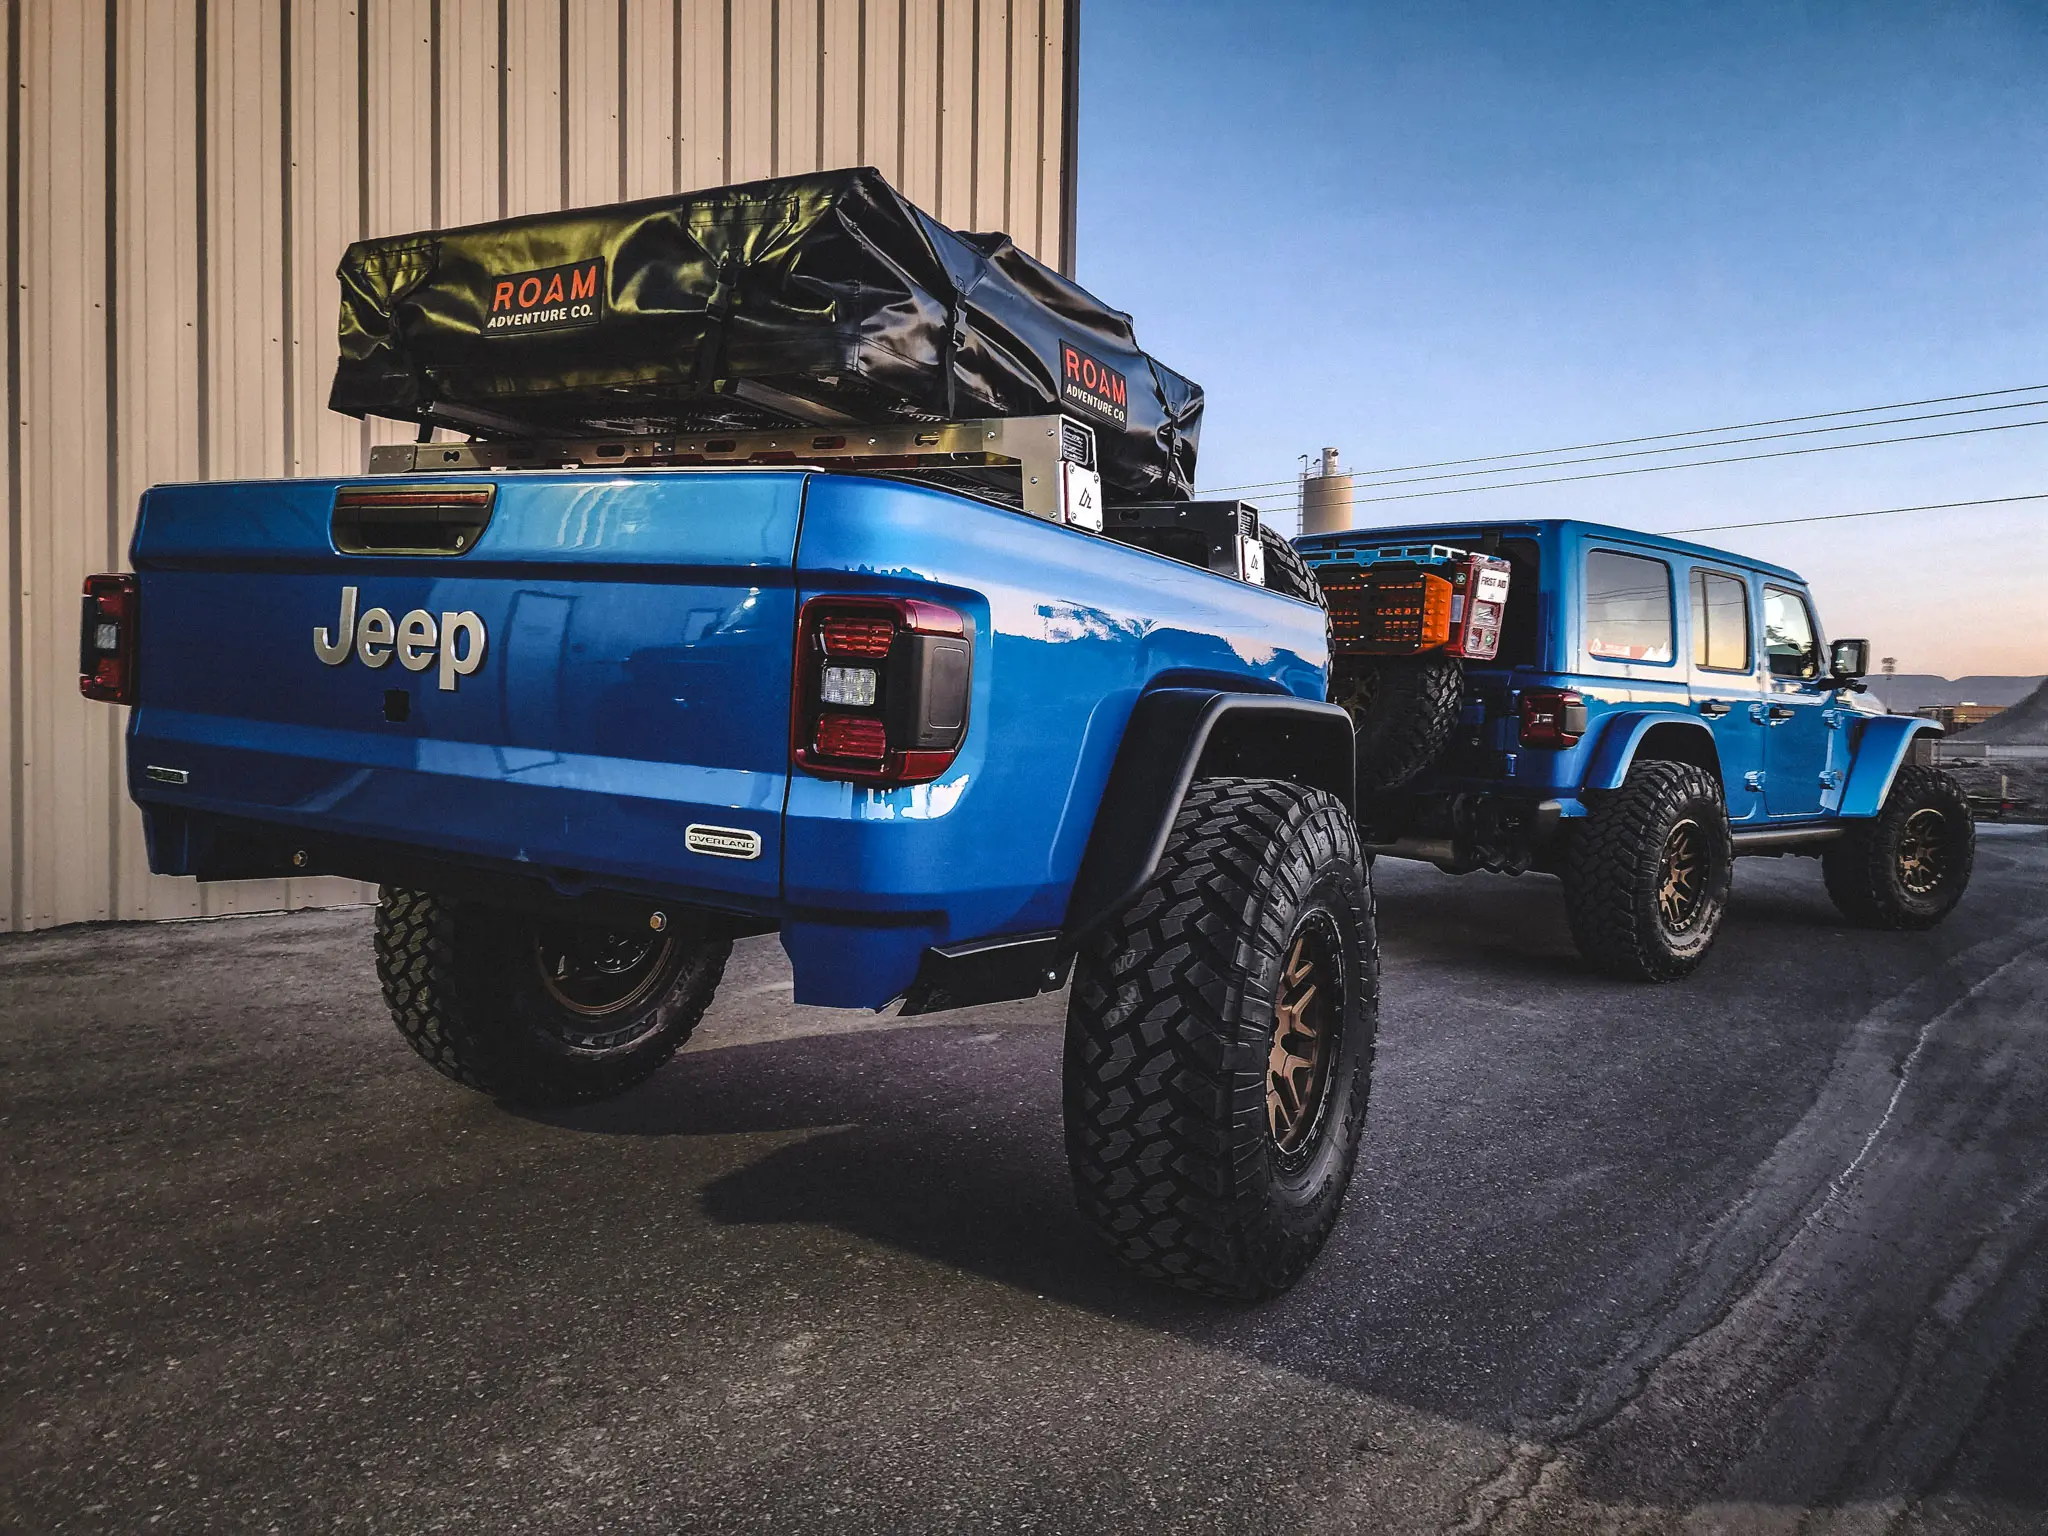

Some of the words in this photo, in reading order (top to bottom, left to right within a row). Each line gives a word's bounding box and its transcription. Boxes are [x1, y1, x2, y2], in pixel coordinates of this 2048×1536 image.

[493, 266, 596, 312] ROAM
[487, 308, 568, 328] ADVENTURE
[570, 303, 594, 319] CO.
[1065, 347, 1126, 407] ROAM
[1066, 384, 1112, 416] ADVENTURE
[1113, 408, 1125, 423] CO.
[1481, 576, 1497, 587] FIRST
[1497, 579, 1507, 588] AID
[313, 586, 486, 690] Jeep
[688, 834, 755, 850] OVERLAND
